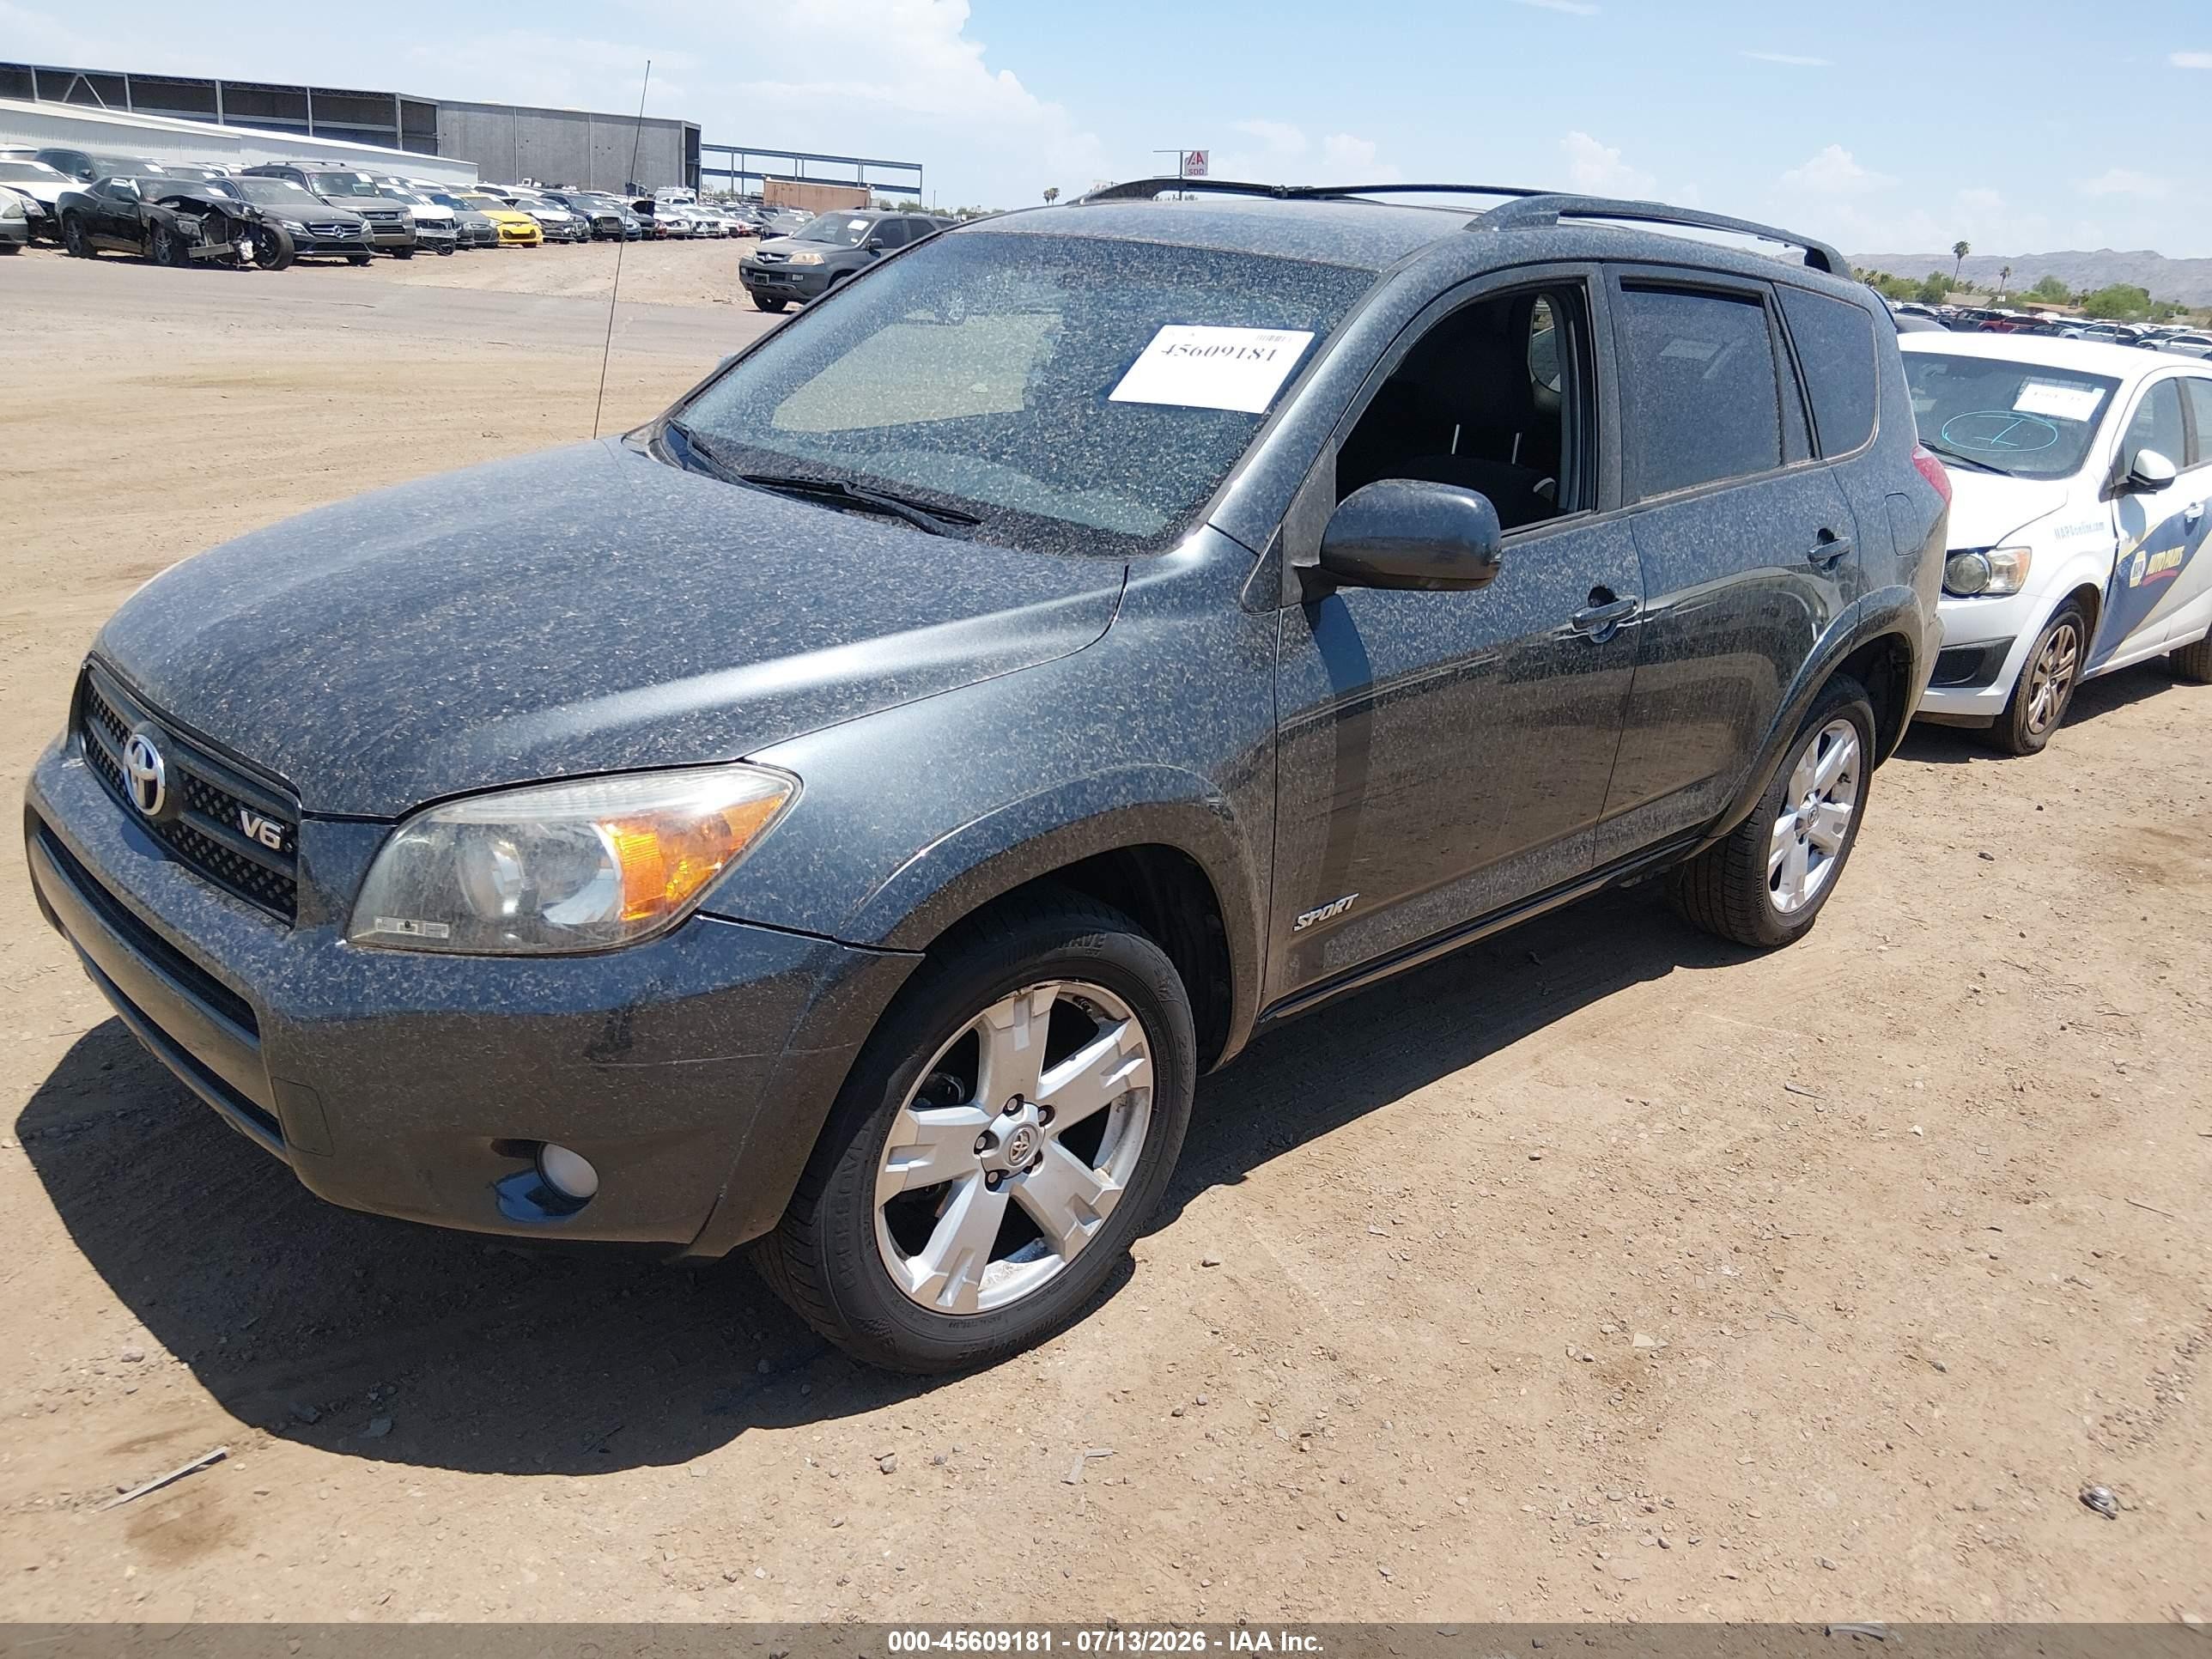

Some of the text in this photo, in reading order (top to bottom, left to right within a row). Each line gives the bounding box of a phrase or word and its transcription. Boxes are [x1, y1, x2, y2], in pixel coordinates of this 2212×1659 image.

[1161, 343, 1278, 362] 45609181
[240, 810, 282, 849] V6
[1293, 892, 1360, 932] SPORT
